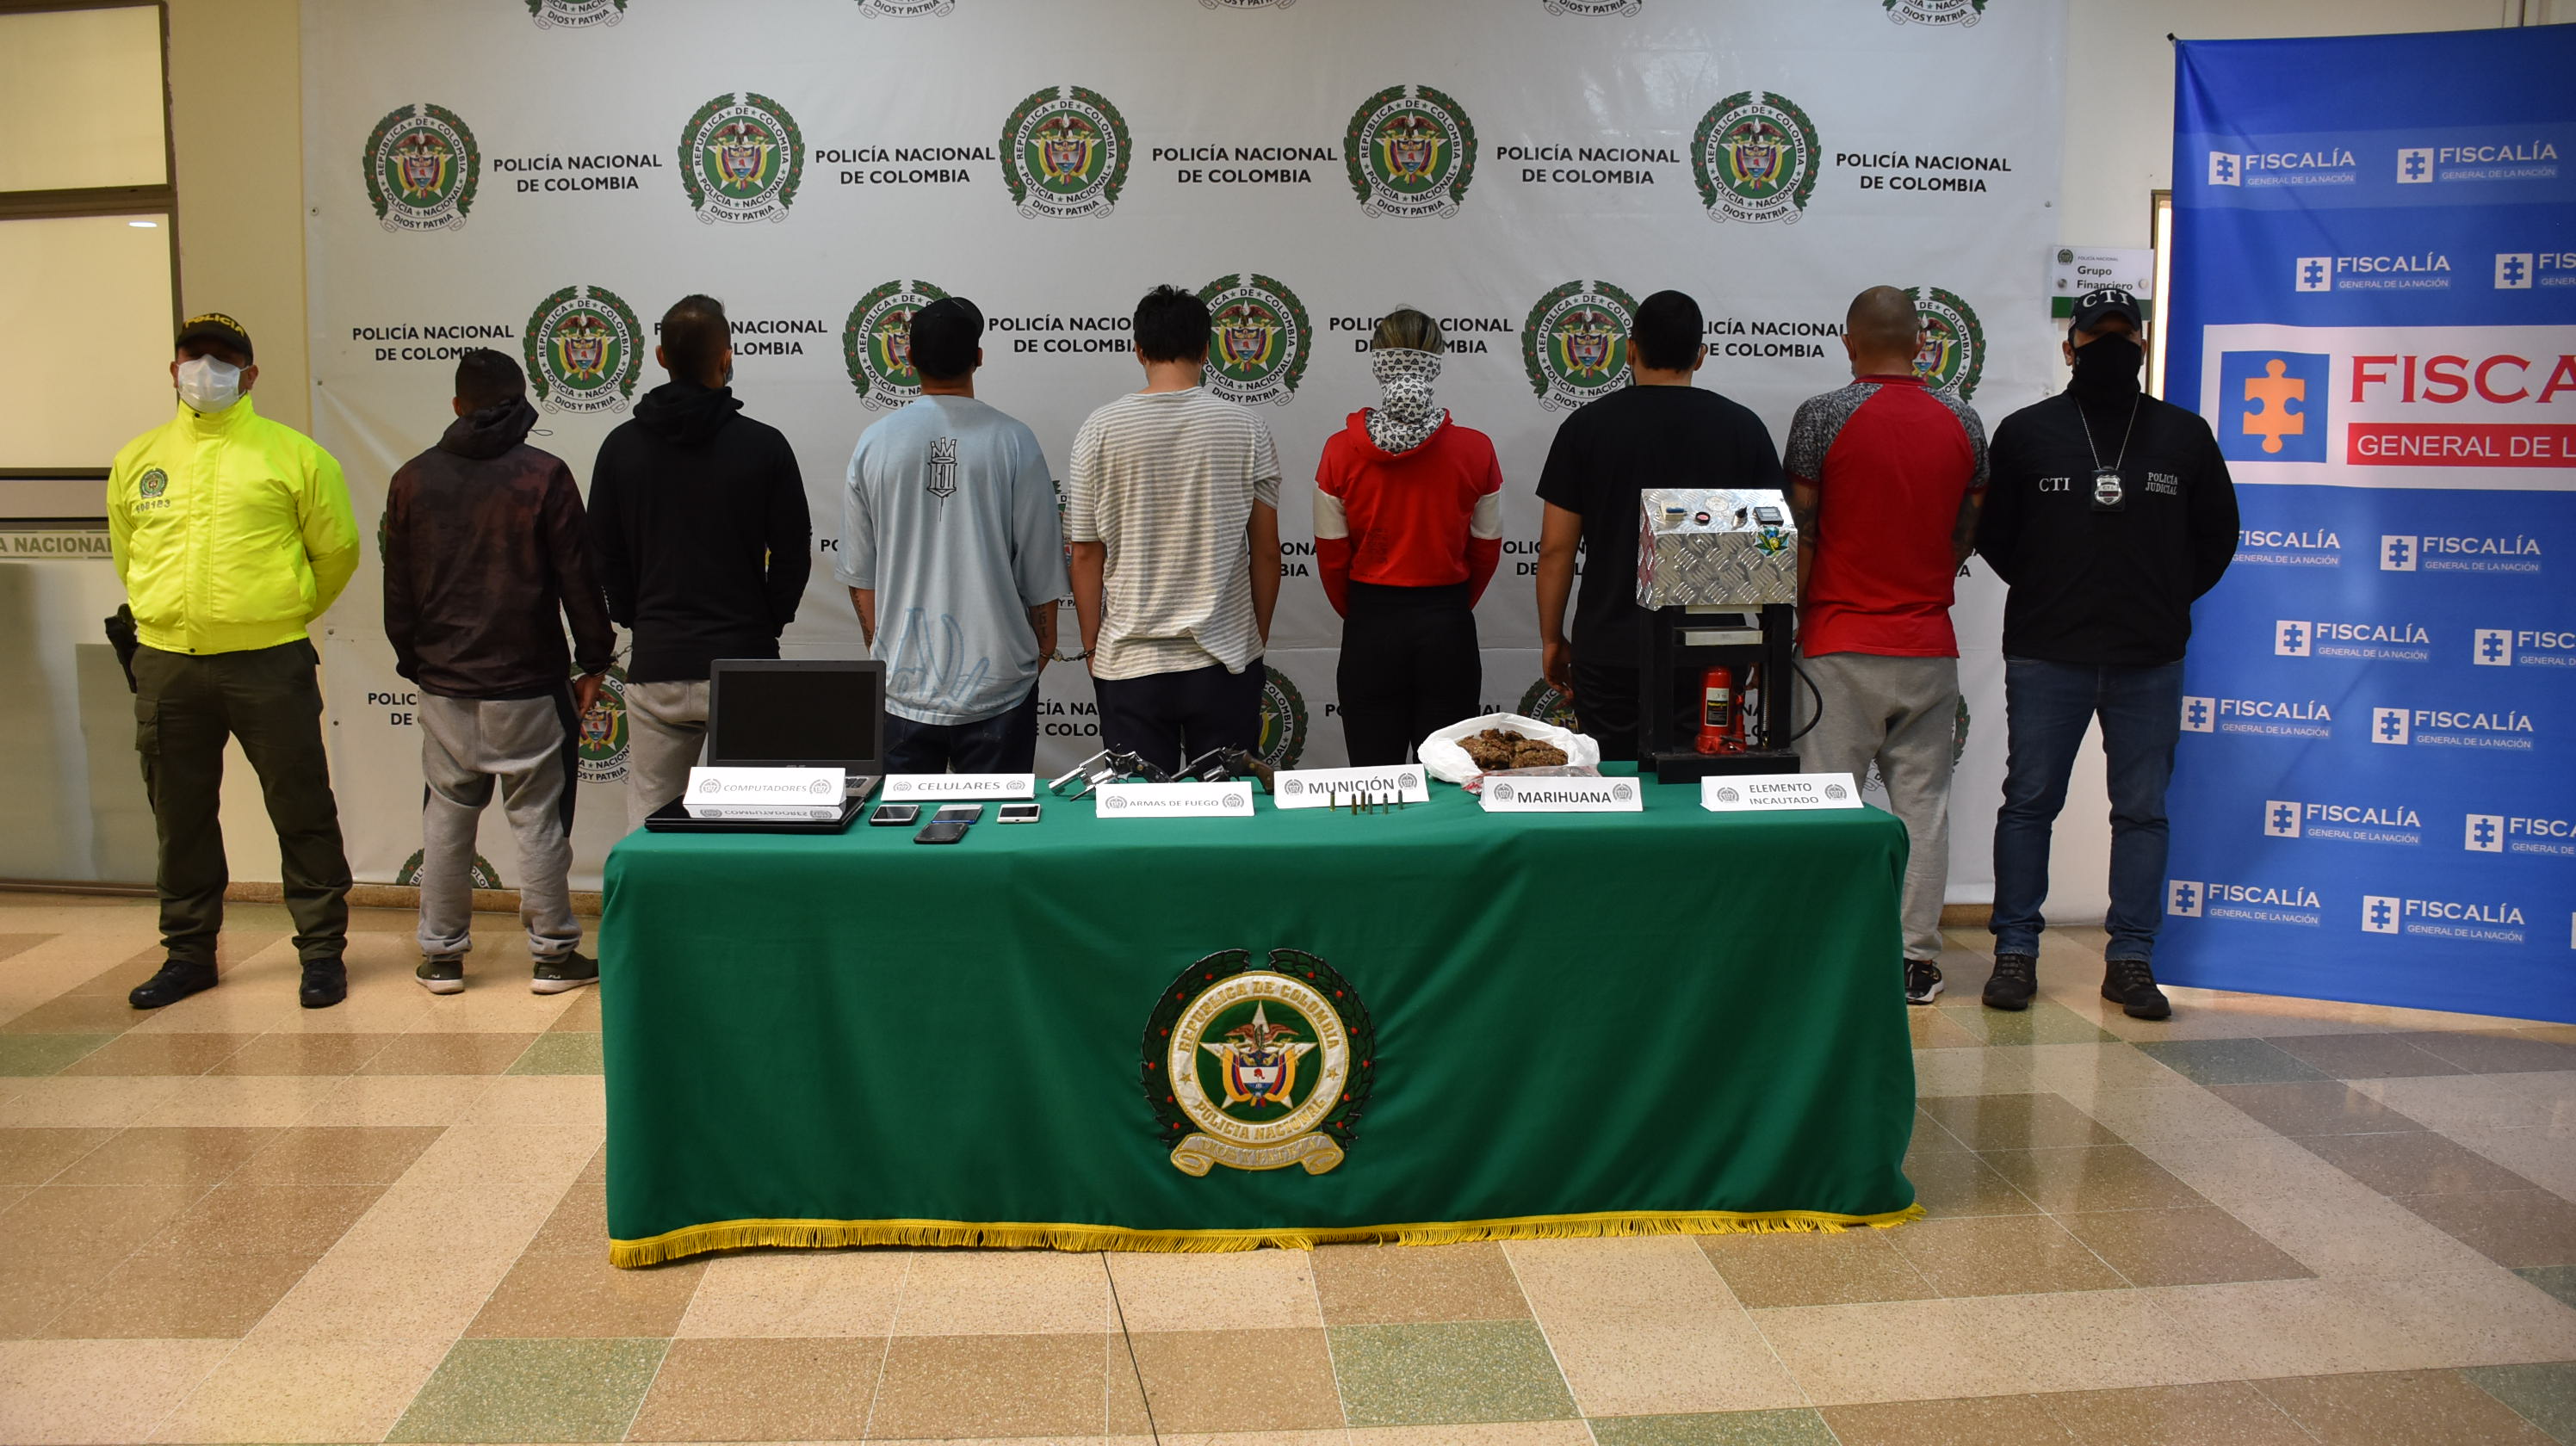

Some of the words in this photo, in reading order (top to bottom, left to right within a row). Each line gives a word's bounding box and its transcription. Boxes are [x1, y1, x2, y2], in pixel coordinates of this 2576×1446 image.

[759, 113, 789, 164] COLOMBIA
[1085, 107, 1115, 159] COLOMBIA
[1430, 106, 1460, 159] COLOMBIA
[1775, 114, 1805, 165] COLOMBIA
[438, 123, 466, 173] COLOMBIA
[816, 146, 889, 163] POLICÍA
[896, 147, 995, 161] NACIONAL
[1153, 145, 1229, 161] POLICÍA
[1235, 148, 1337, 161] NACIONAL
[1497, 145, 1572, 161] POLICÍA
[1579, 148, 1680, 163] NACIONAL
[2440, 140, 2557, 164] FISCALÍA
[494, 154, 562, 171] POLICÍA
[568, 155, 662, 169] NACIONAL
[1837, 151, 1909, 168] POLICÍA
[1916, 156, 2011, 171] NACIONAL
[2245, 148, 2356, 170] FISCALÍA
[517, 179, 539, 192] DE
[545, 177, 638, 191] COLOMBIA
[841, 171, 864, 184] DE
[870, 170, 969, 183] COLOMBIA
[1179, 170, 1202, 182] DE
[1209, 170, 1311, 183] COLOMBIA
[1523, 170, 1545, 182] DE
[1552, 170, 1654, 183] COLOMBIA
[1861, 176, 1883, 188] DE
[1890, 177, 1986, 192] COLOMBIA
[742, 176, 785, 207] NACIONAL
[1066, 171, 1111, 203] NACIONAL
[1411, 171, 1457, 202] NACIONAL
[1756, 177, 1800, 207] NACIONAL
[423, 184, 463, 216] NACIONAL
[1066, 200, 1099, 215] PATRIA
[1411, 200, 1445, 215] PATRIA
[743, 205, 775, 220] PATRIA
[2337, 251, 2450, 273] FISCALÍA
[2078, 265, 2112, 277] Grupo
[2077, 280, 2133, 290] Financiero
[2083, 289, 2130, 307] CTI
[731, 320, 827, 334] NACIONAL
[989, 314, 1064, 331] POLICÍA
[1069, 318, 1135, 331] NACIO
[1265, 294, 1295, 347] COLOMBIA
[1440, 318, 1514, 332] CIONAL
[353, 324, 419, 340] POLICÍA
[424, 325, 514, 339] NACIONAL
[600, 306, 629, 356] COLOMBIA
[375, 348, 397, 361] DE
[734, 342, 803, 355] LOMBIA
[1014, 339, 1038, 352] DE
[1043, 339, 1137, 353] COLOMBI
[1725, 343, 1825, 357] COLOMBIA
[1246, 359, 1291, 390] NACIONAL
[2350, 354, 2576, 404] FISCA
[585, 368, 625, 399] NACIONAL
[1246, 386, 1279, 403] PATRIA
[2357, 435, 2500, 456] GENERAL
[2511, 436, 2551, 458] DE
[2039, 477, 2071, 491] CTI
[2145, 482, 2177, 496] JUDICIAL
[2423, 535, 2541, 555] FISCALÍA
[2303, 555, 2338, 565] NACIÓN
[2425, 561, 2468, 570] GENERAL
[2501, 561, 2539, 572] NACIÓN
[2317, 623, 2430, 644] FISCALÍA
[2319, 647, 2361, 657] GENERAL
[2392, 651, 2427, 659] NACIÓN
[2521, 656, 2566, 665] GENERAL
[2220, 699, 2331, 720] FISCALÍA
[391, 714, 412, 725] DE
[2415, 710, 2534, 732] FISCALÍA
[2222, 723, 2263, 732] GENERAL
[2281, 726, 2294, 735] LA
[2294, 727, 2329, 737] NACIÓN
[2418, 735, 2461, 745] GENERAL
[2493, 738, 2531, 748] NACIÓN
[918, 782, 1000, 791] CELULARES
[1309, 776, 1395, 794] MUNICIÓN
[1749, 782, 1811, 793] ELEMENTO
[1517, 791, 1612, 803] MARIHUANA
[1749, 796, 1819, 805] INCAUTADO
[2307, 803, 2421, 827] FISCALÍA
[2308, 829, 2352, 839] GENERAL
[2354, 831, 2367, 840] DE
[2369, 832, 2381, 841] LA
[2382, 833, 2418, 844] NACIÓN
[2511, 843, 2558, 853] GENERAL
[2561, 846, 2575, 855] DE
[2208, 883, 2321, 908] FISCALÍA
[2210, 908, 2252, 919] GENERAL
[2255, 911, 2267, 920] DE
[2282, 914, 2319, 924] NACIÓN
[2406, 899, 2525, 925] FISCALÍA
[2407, 924, 2453, 936] GENERAL
[2455, 929, 2468, 937] DE
[2485, 930, 2523, 942] NACIÓN
[1253, 980, 1275, 994] DE
[1280, 984, 1341, 1050] COLOMBIA
[1254, 1098, 1328, 1140] NACIONAL
